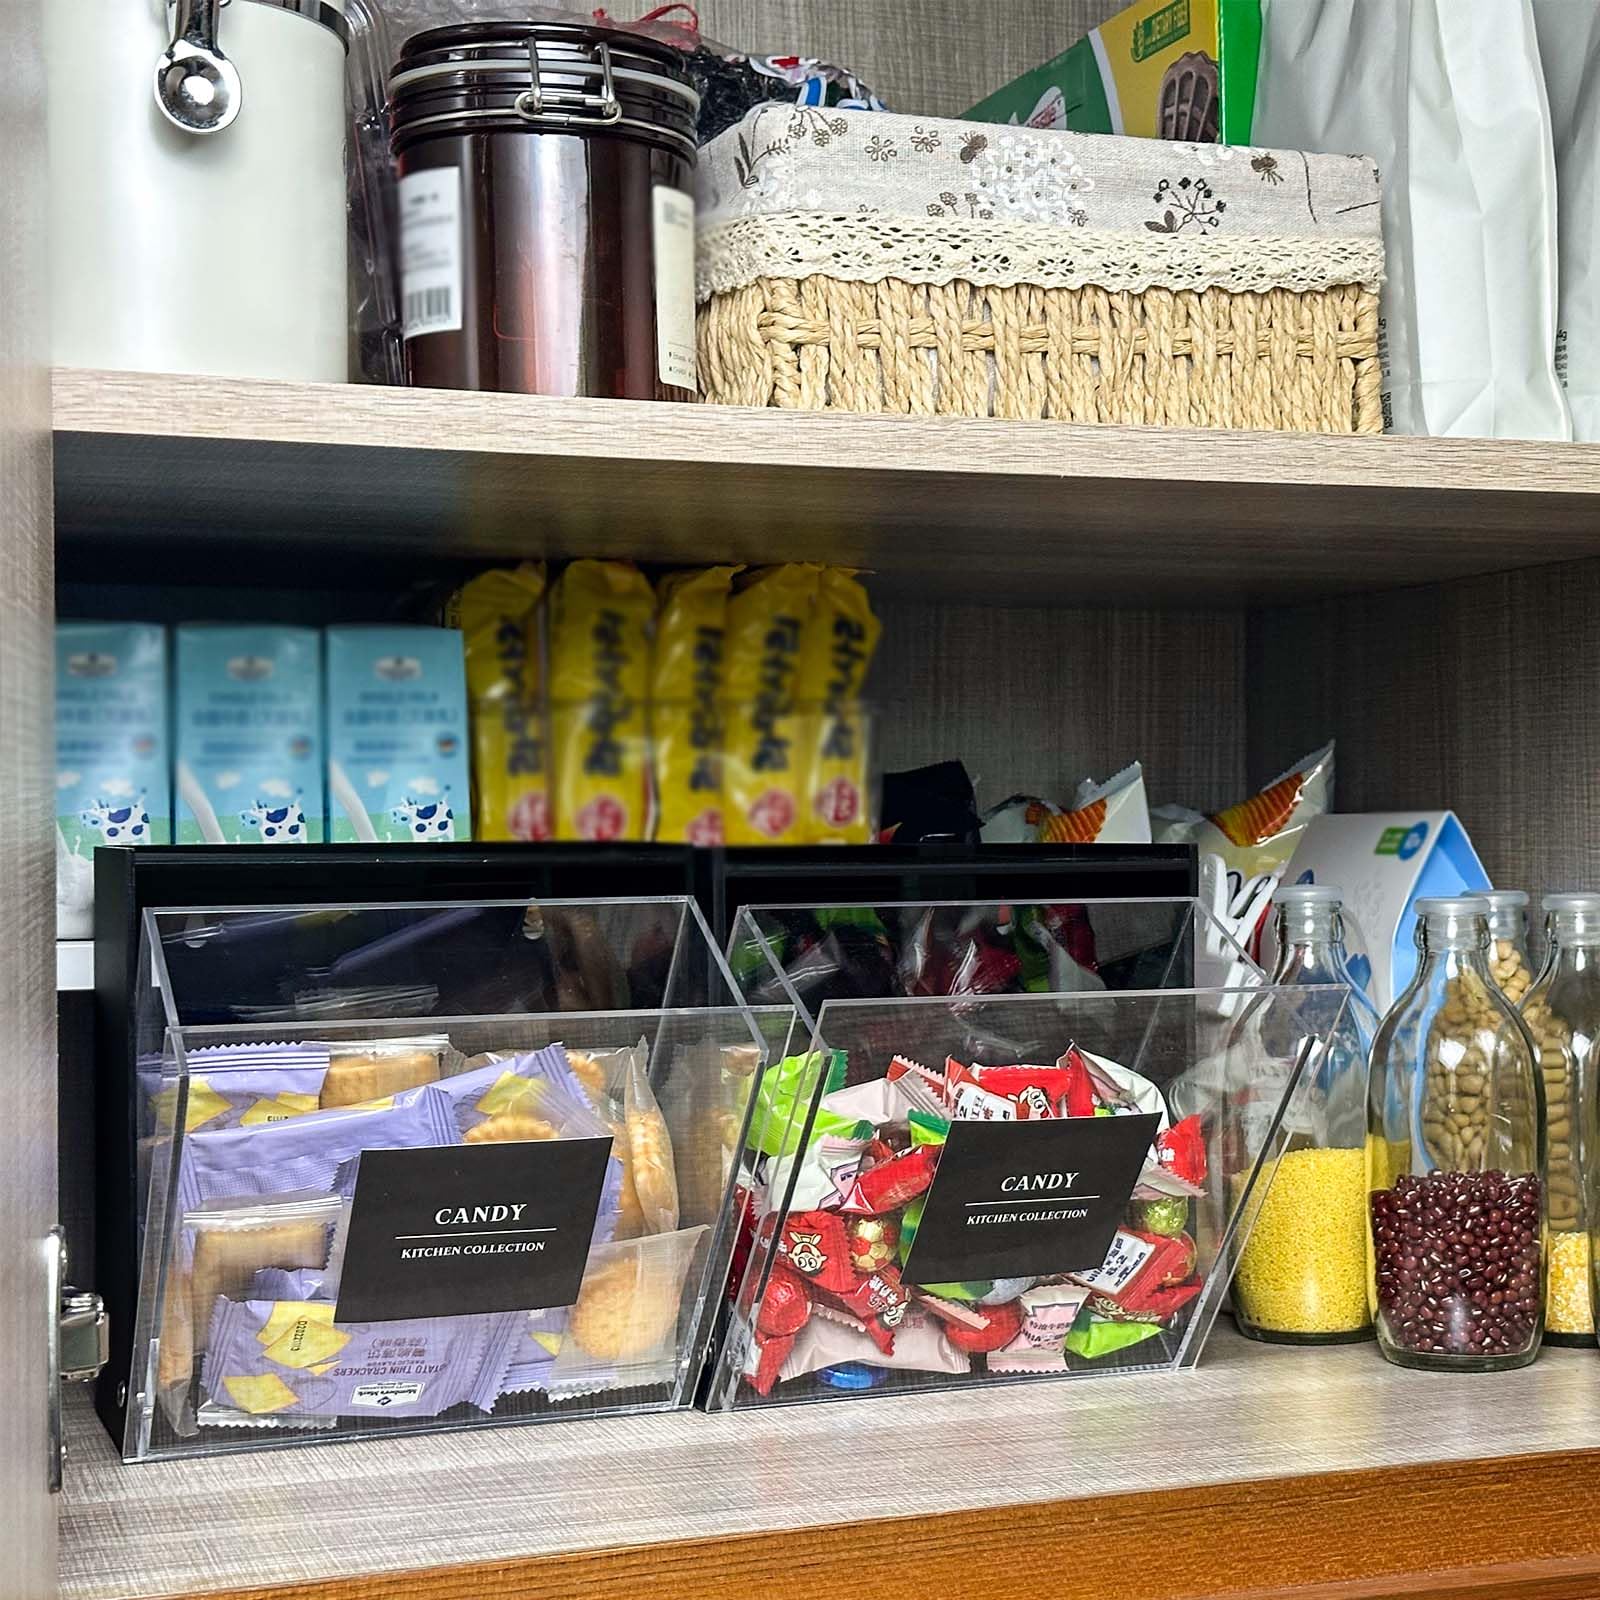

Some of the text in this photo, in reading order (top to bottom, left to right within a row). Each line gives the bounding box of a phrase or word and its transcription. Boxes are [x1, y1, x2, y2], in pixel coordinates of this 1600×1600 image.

[1001, 1171, 1079, 1193] CANDY
[435, 1203, 527, 1225] CANDY
[966, 1208, 1089, 1226] KITCHEN COLLECTION
[400, 1241, 546, 1260] KITCHEN COLLECTION
[333, 1365, 387, 1377] CRACKERS
[389, 1365, 412, 1376] THIN
